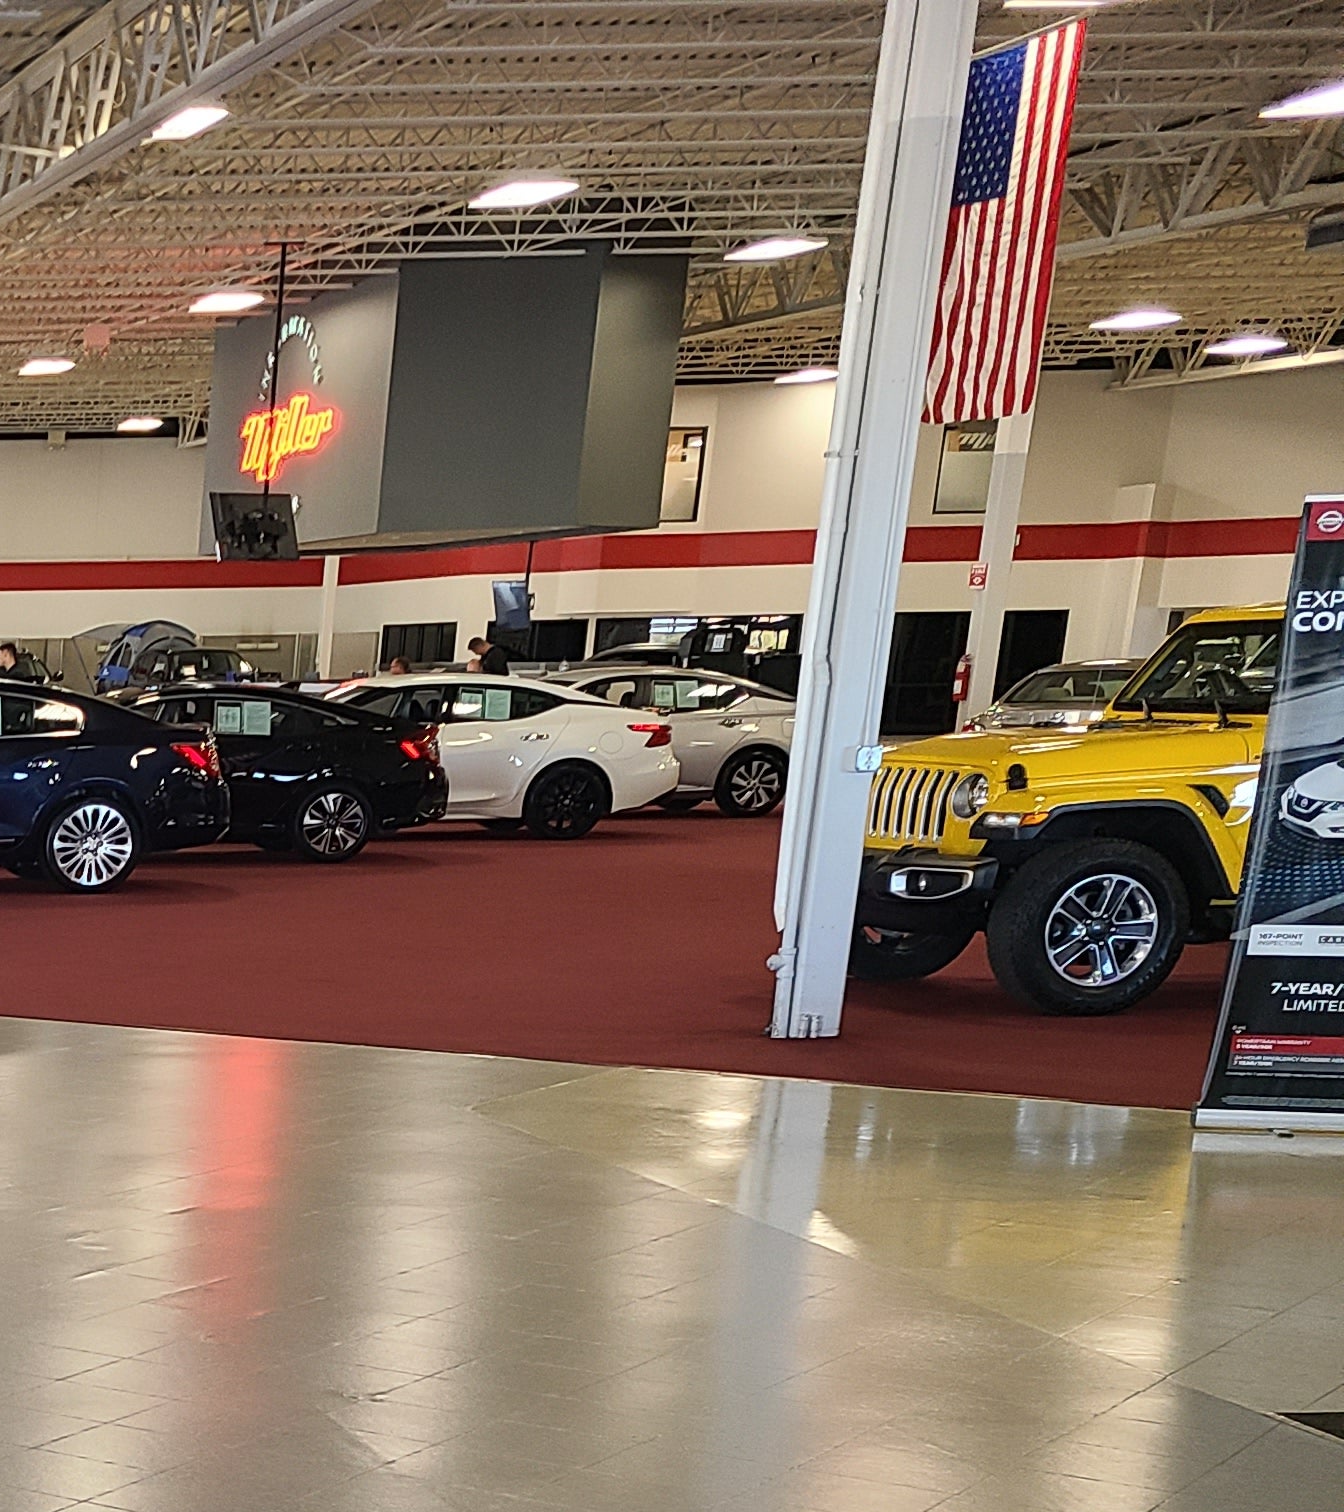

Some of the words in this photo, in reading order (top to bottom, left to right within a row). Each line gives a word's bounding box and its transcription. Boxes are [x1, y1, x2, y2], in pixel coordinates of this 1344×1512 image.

[240, 394, 333, 484] Miller
[1296, 590, 1344, 609] EXP
[1270, 982, 1344, 997] 7-YEAR/
